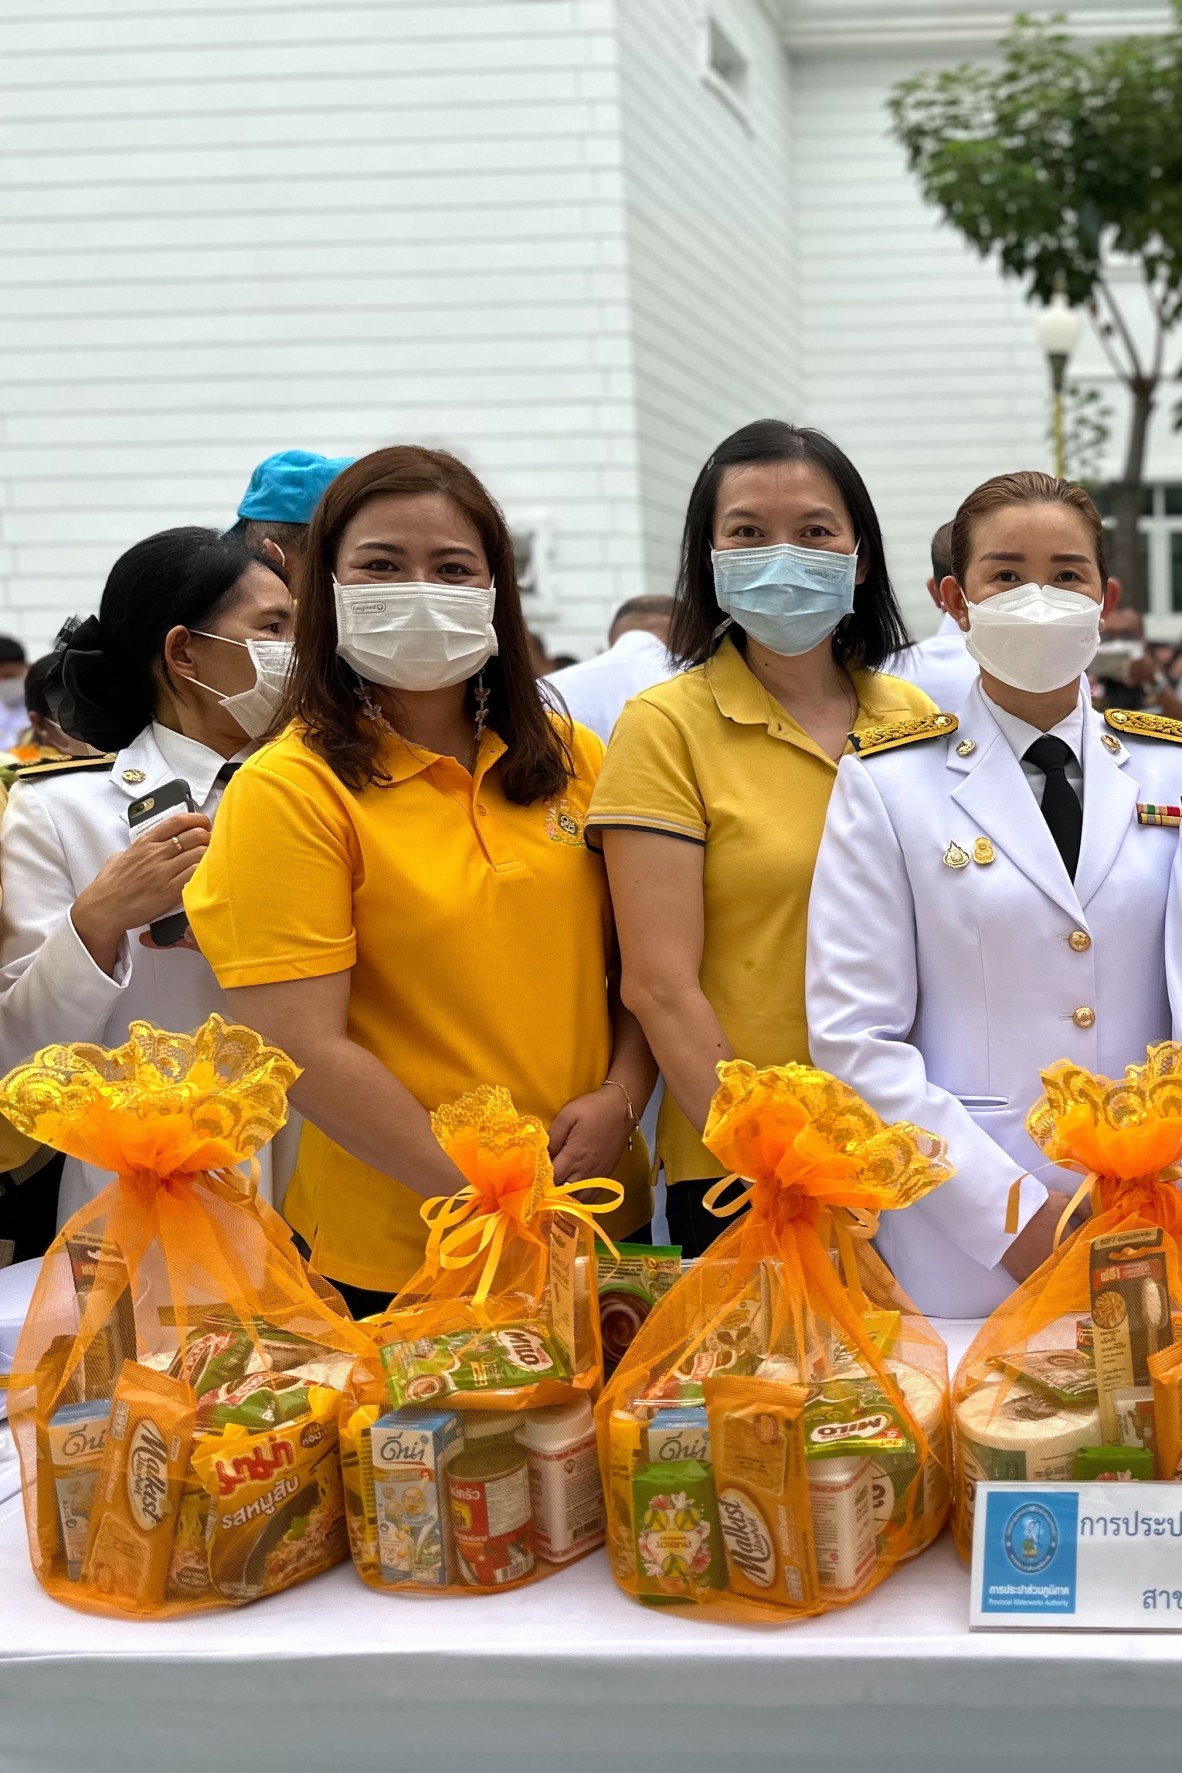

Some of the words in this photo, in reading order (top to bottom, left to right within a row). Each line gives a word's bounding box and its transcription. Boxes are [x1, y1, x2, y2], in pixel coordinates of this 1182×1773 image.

[504, 1332, 540, 1365] MILO
[818, 1417, 882, 1435] MILO
[132, 1422, 169, 1525] Malkist
[215, 1435, 294, 1496] มาม่า
[221, 1474, 299, 1530] รสหมูสับ
[720, 1497, 772, 1584] Malkist
[989, 1584, 1069, 1597] การประปาส่วนภูมิภาค
[1013, 1598, 1043, 1606] Waterworks
[1045, 1599, 1069, 1607] Authority
